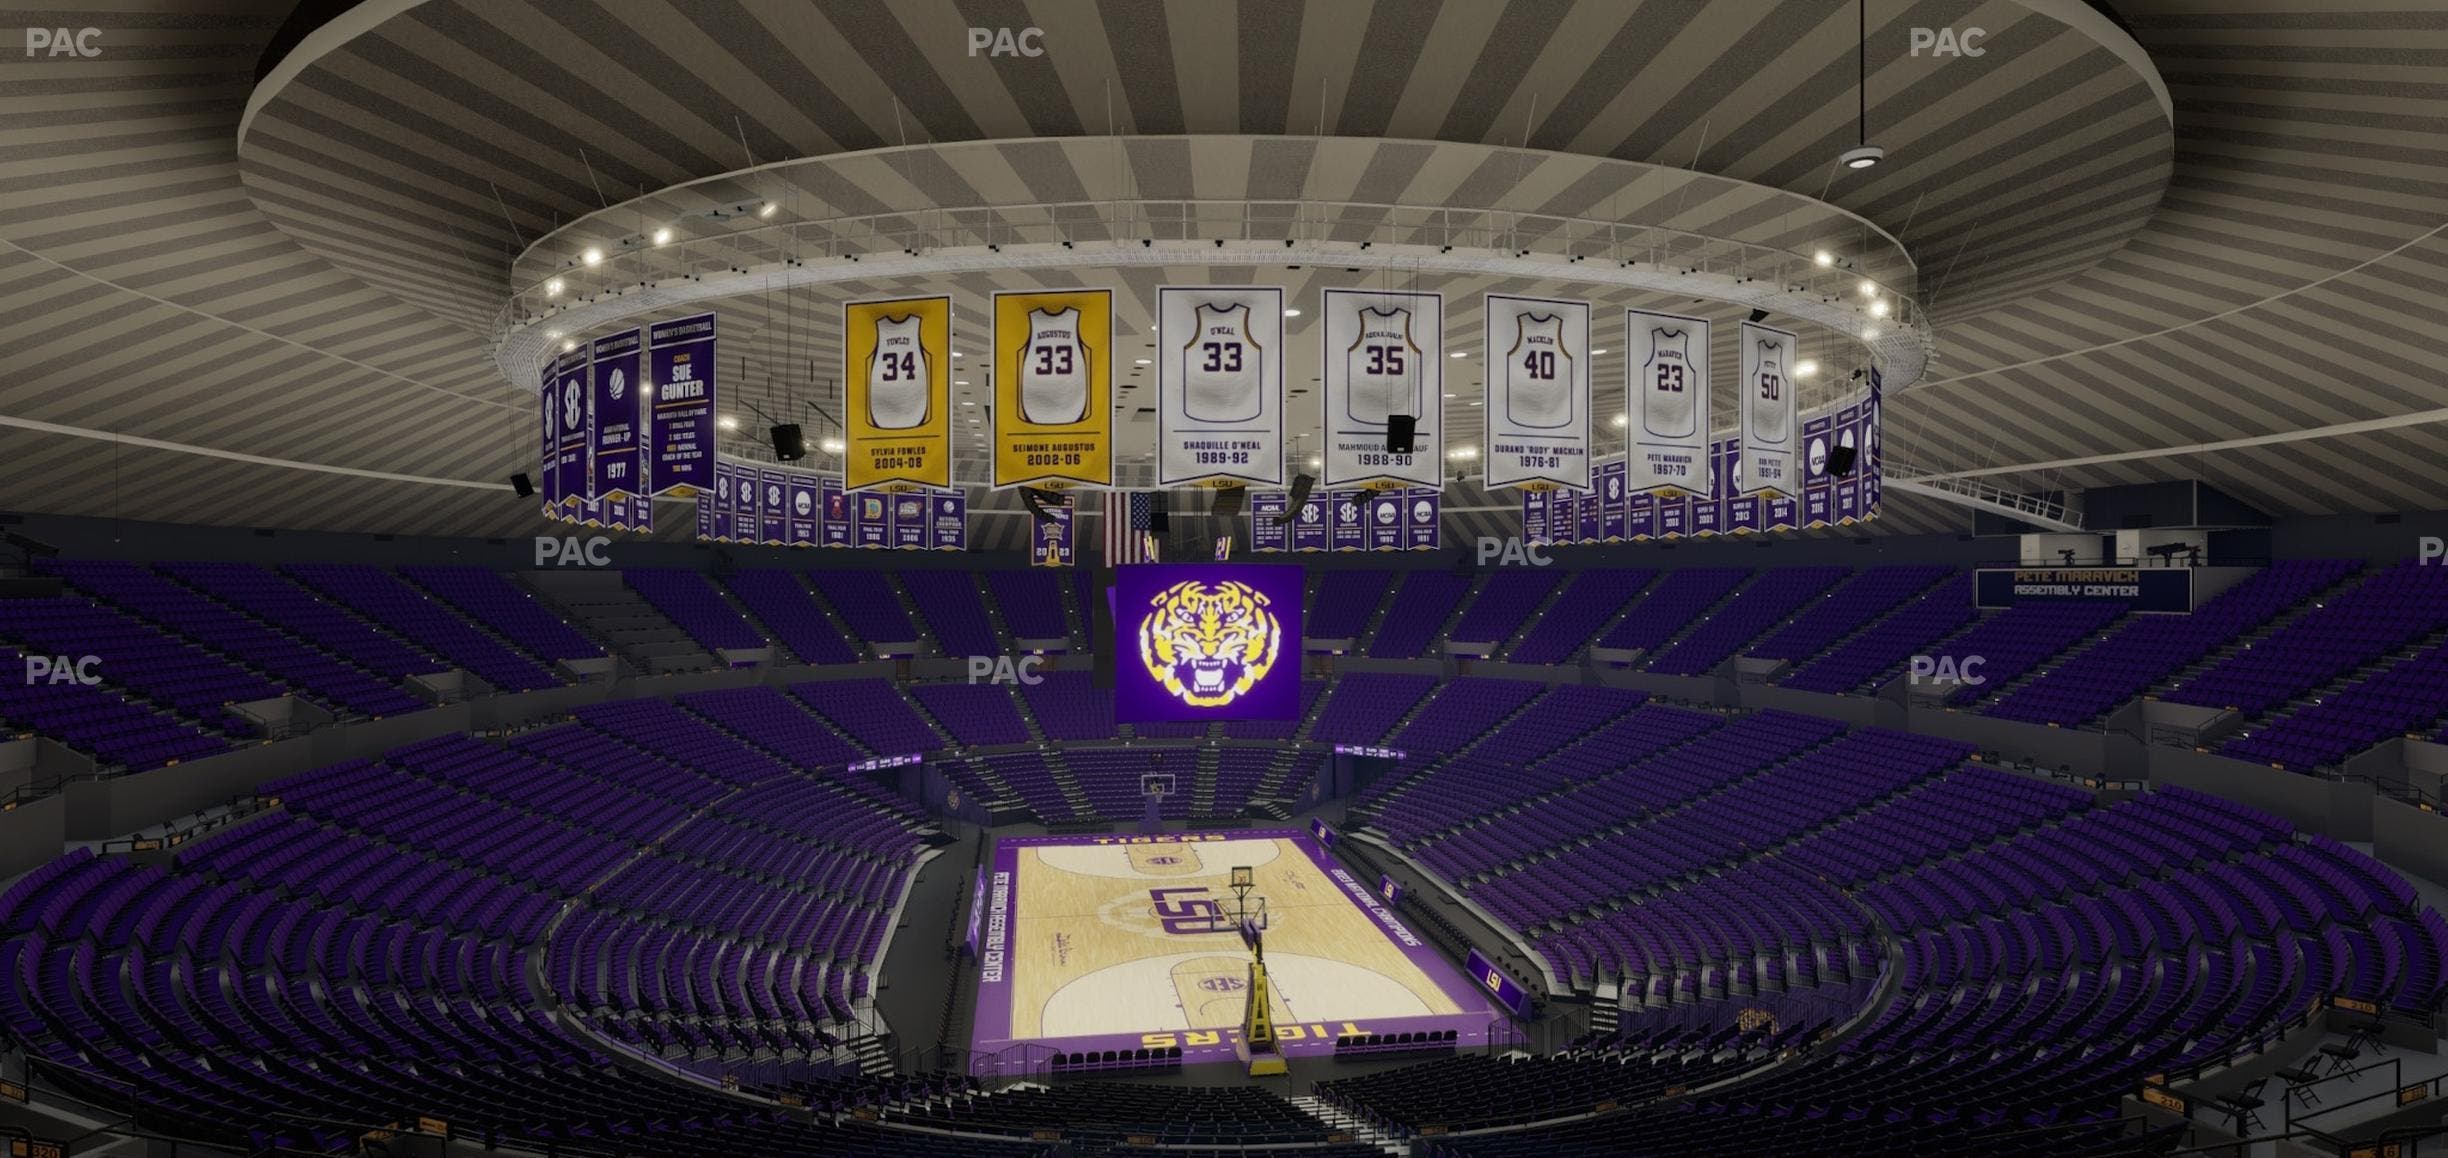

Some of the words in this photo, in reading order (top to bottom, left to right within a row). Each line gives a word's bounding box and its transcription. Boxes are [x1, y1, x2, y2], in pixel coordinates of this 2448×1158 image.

[1037, 330, 1071, 340] AUGUSTUS
[1210, 327, 1235, 335] O'NEAL
[886, 337, 910, 346] FOWLES
[1527, 336, 1554, 345] MACKLIN
[1035, 345, 1073, 375] 33
[1203, 342, 1242, 372] 33
[1366, 345, 1404, 375] 35
[882, 351, 916, 381] 34
[1524, 350, 1555, 380] 40
[672, 363, 692, 382] SUE
[1658, 363, 1682, 392] 23
[661, 380, 704, 400] GUNTER
[1761, 373, 1779, 401] 50
[871, 448, 895, 456] SYLVIA
[897, 446, 926, 456] FOWLES
[1013, 444, 1050, 452] SEIMONE
[1052, 443, 1095, 452] AUGUSTUS
[1184, 441, 1229, 449] SHAQUILLE
[1232, 441, 1261, 450] O'NEAL
[1338, 443, 1379, 452] MAHMOUD
[1495, 444, 1525, 454] DURAND
[1553, 446, 1584, 456] MACKLIN
[874, 457, 923, 469] 2004-08
[1027, 454, 1081, 465] 2002-06
[1196, 452, 1249, 464] 1989-92
[1358, 454, 1412, 466] 1988-90
[1519, 455, 1560, 468] 1976-81
[1647, 453, 1661, 461] PETE
[1663, 455, 1692, 463] MARAVICH
[607, 462, 626, 479] 1977
[1653, 463, 1686, 476] 1967-70
[1301, 503, 1319, 523] SEC
[1340, 502, 1358, 522] SEC
[1774, 507, 1787, 518] 2014
[1036, 547, 1047, 556] 20
[1059, 547, 1070, 556] 23
[2014, 570, 2051, 582] PETE
[2055, 570, 2139, 582] MARAVICH
[2014, 584, 2080, 596] ASSEMBLY
[2084, 585, 2139, 596] CENTER
[1093, 834, 1226, 845] TIGERS
[1149, 887, 1226, 935] LSU
[1371, 907, 1423, 947] CHAMPIONS
[982, 951, 1004, 982] CENTER
[1486, 969, 1502, 992] LSU
[33, 1146, 58, 1158] 320
